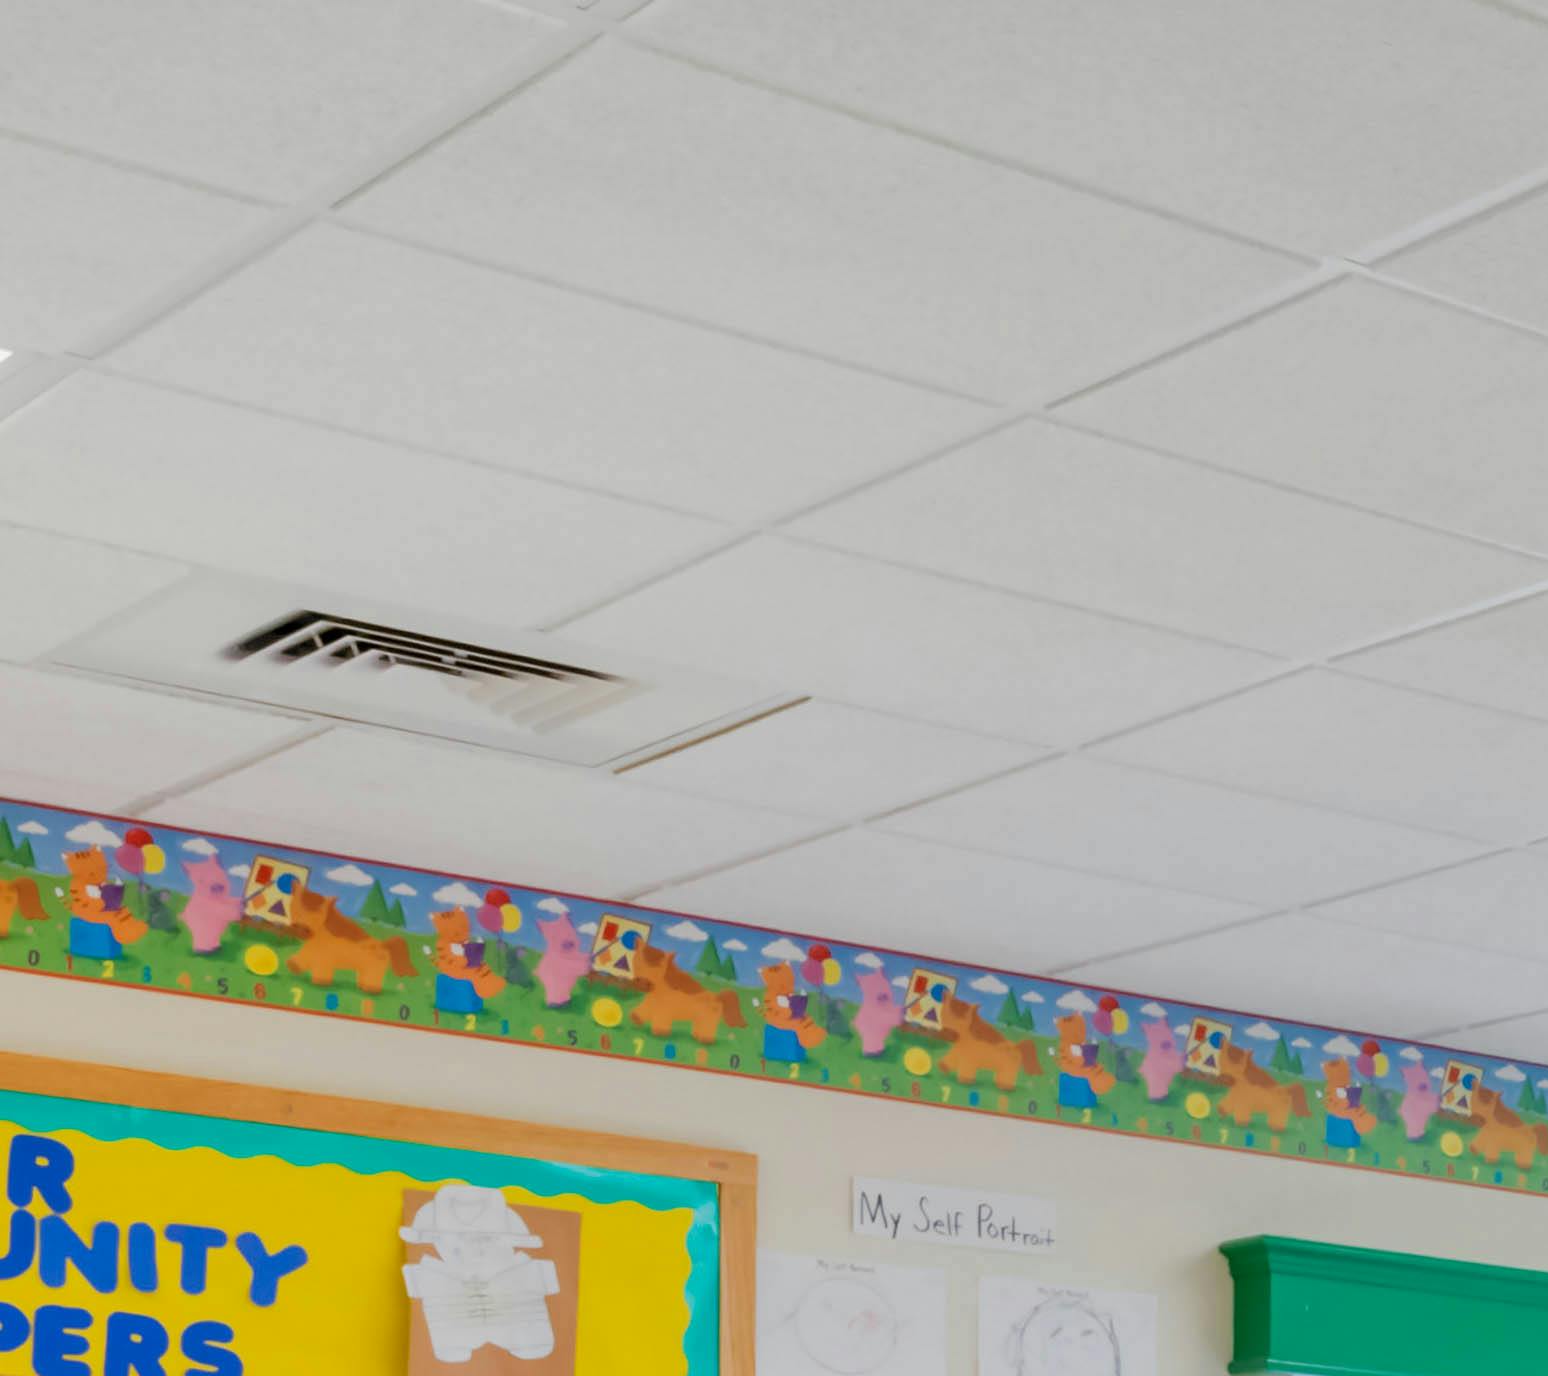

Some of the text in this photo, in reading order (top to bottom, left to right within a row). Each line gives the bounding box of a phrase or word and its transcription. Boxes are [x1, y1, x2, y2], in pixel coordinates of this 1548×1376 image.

[28, 950, 40, 966] 0
[102, 960, 115, 978] 2
[217, 978, 228, 994] 5
[290, 986, 304, 1007] 7
[400, 1004, 410, 1020] 0
[464, 1014, 476, 1032] 2
[568, 1030, 578, 1046] 5
[730, 1054, 740, 1070] 0
[6, 1133, 75, 1215] R
[860, 1191, 1056, 1246] My Self Portrait
